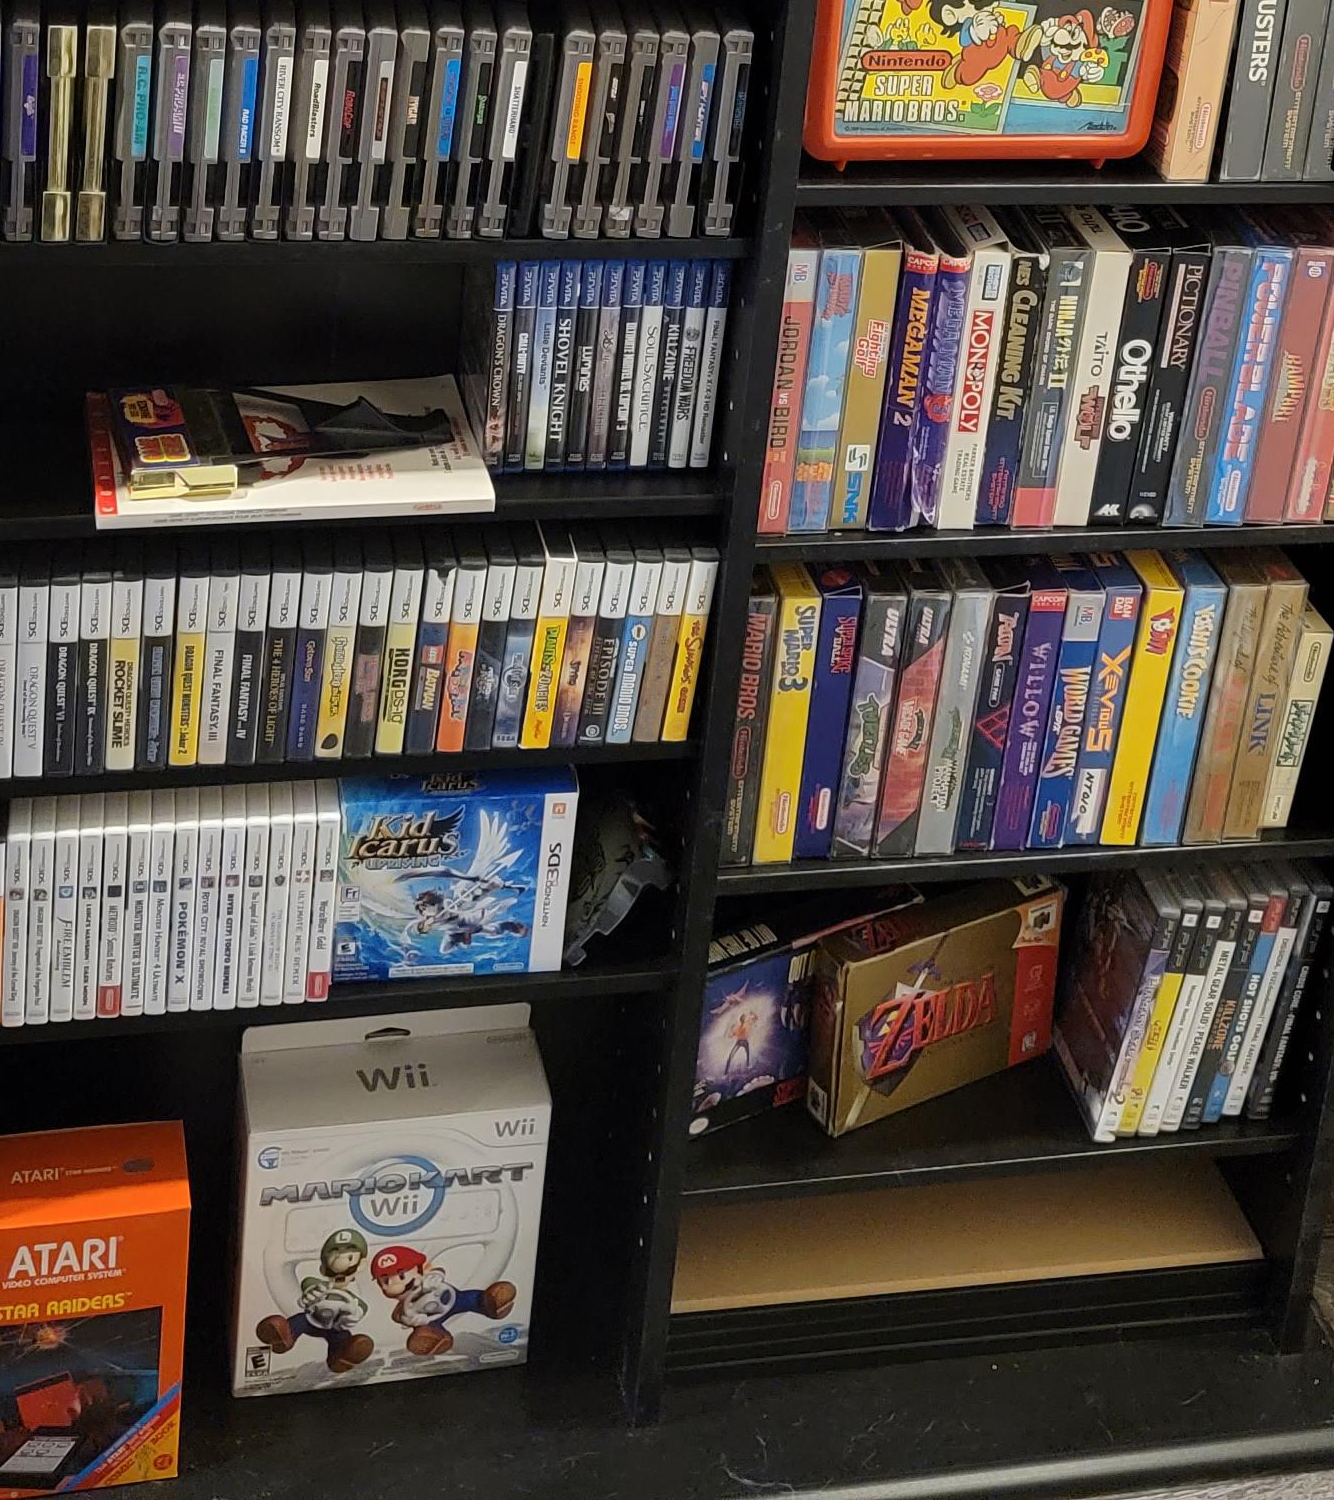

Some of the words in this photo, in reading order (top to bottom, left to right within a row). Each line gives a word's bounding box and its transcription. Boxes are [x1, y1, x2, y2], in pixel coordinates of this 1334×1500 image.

[867, 53, 948, 69] Nintendo
[873, 75, 933, 97] SUPER
[842, 100, 901, 124] MARIO
[901, 100, 966, 125] BROS.
[1169, 263, 1205, 371] PICTIONARY
[555, 318, 571, 379] SHOVEL
[1089, 332, 1109, 377] TAITO
[1107, 339, 1152, 442] Othello
[550, 383, 567, 442] KNIGHT
[843, 472, 863, 524] SNK
[881, 607, 899, 657] ULTRA
[1018, 641, 1052, 737] WILLOW
[1249, 693, 1275, 756] LINK
[367, 811, 437, 840] Kid
[346, 830, 461, 860] Icarus
[365, 856, 443, 869] UPRISING
[175, 902, 188, 971] POKÉMON
[174, 974, 185, 984] X
[867, 973, 997, 1082] ZELDA
[356, 1063, 432, 1093] Wii
[494, 1118, 536, 1138] Wii
[11, 1168, 61, 1184] ATARI
[259, 1162, 534, 1207] MARIOKART
[370, 1194, 420, 1218] Wii
[8, 1236, 119, 1279] ATARI
[3, 1278, 32, 1290] VIDEO
[34, 1272, 86, 1287] COMPUTER
[87, 1269, 123, 1282] SYSTEM
[46, 1292, 126, 1316] RAIDERS
